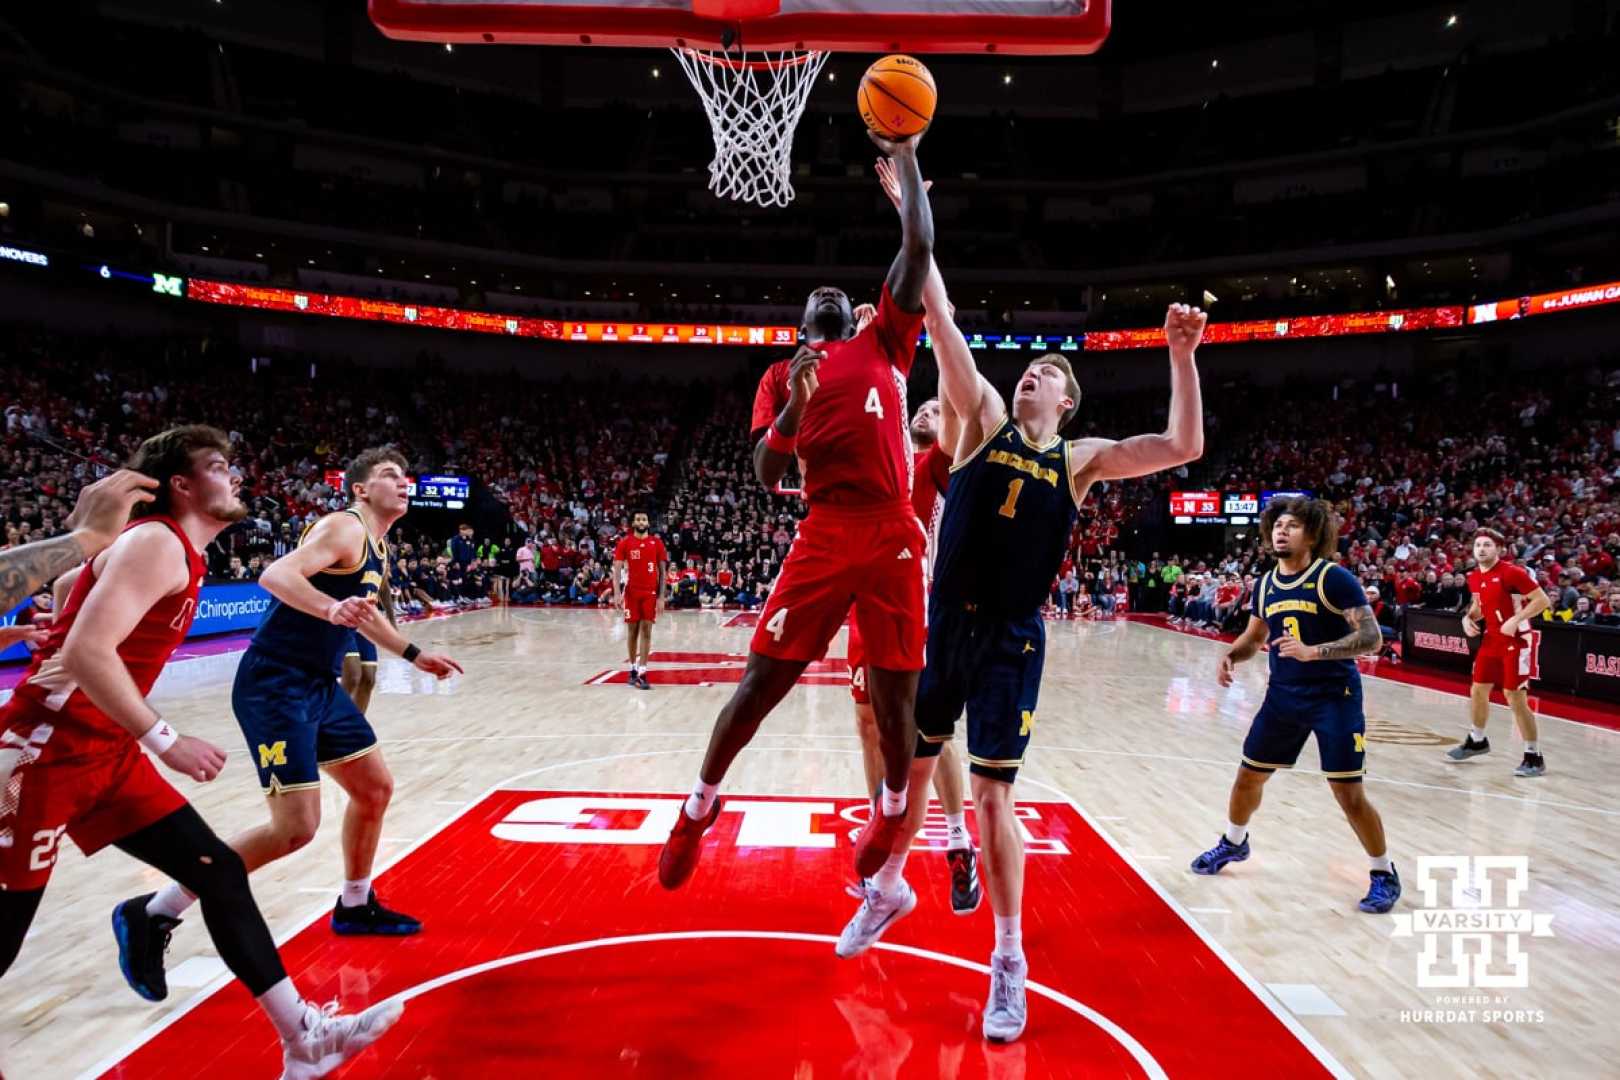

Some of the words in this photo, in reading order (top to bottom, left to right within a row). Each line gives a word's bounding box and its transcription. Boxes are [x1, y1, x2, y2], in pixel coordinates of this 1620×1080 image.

[100, 265, 111, 278] 6
[153, 273, 182, 297] M
[864, 387, 885, 420] 4
[999, 478, 1024, 519] 1
[766, 607, 788, 642] 4
[1414, 631, 1470, 655] NEBRASKA
[258, 740, 288, 768] M
